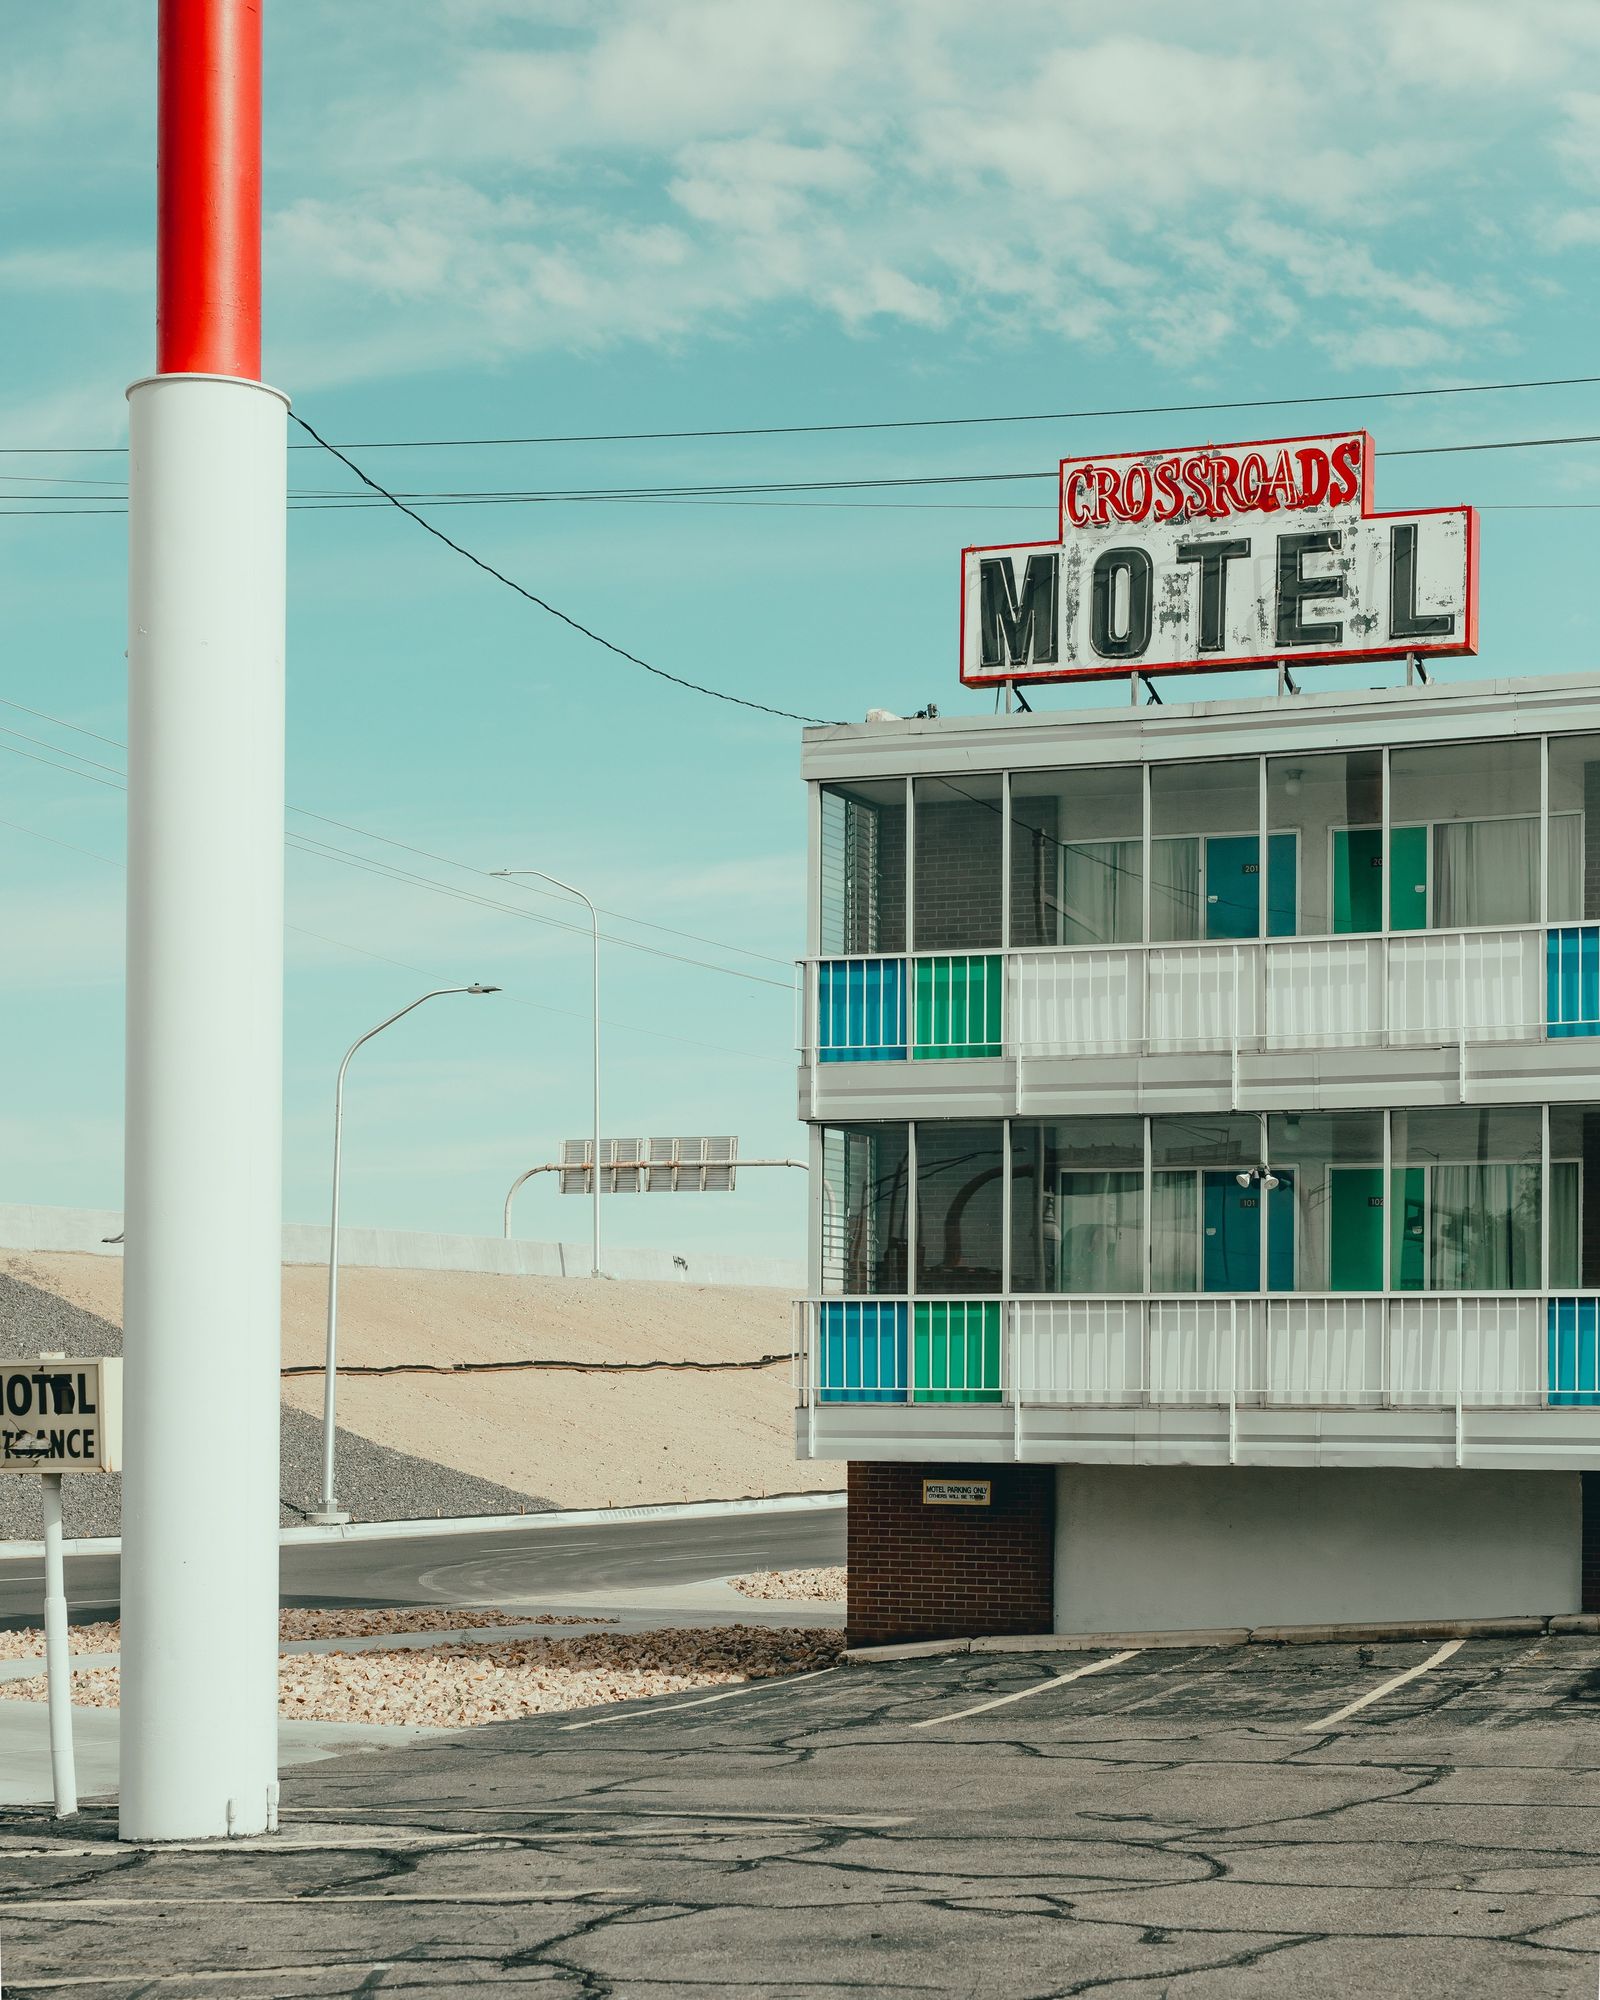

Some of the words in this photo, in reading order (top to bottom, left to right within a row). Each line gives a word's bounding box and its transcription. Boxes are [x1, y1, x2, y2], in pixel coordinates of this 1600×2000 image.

[1063, 440, 1362, 528] CROSSROADS
[979, 523, 1456, 668] MOTEL
[1245, 865, 1258, 873] 201
[1243, 1199, 1255, 1207] 101
[1371, 1198, 1384, 1206] 102
[927, 1485, 945, 1493] MOTEL
[947, 1486, 972, 1494] PARKING
